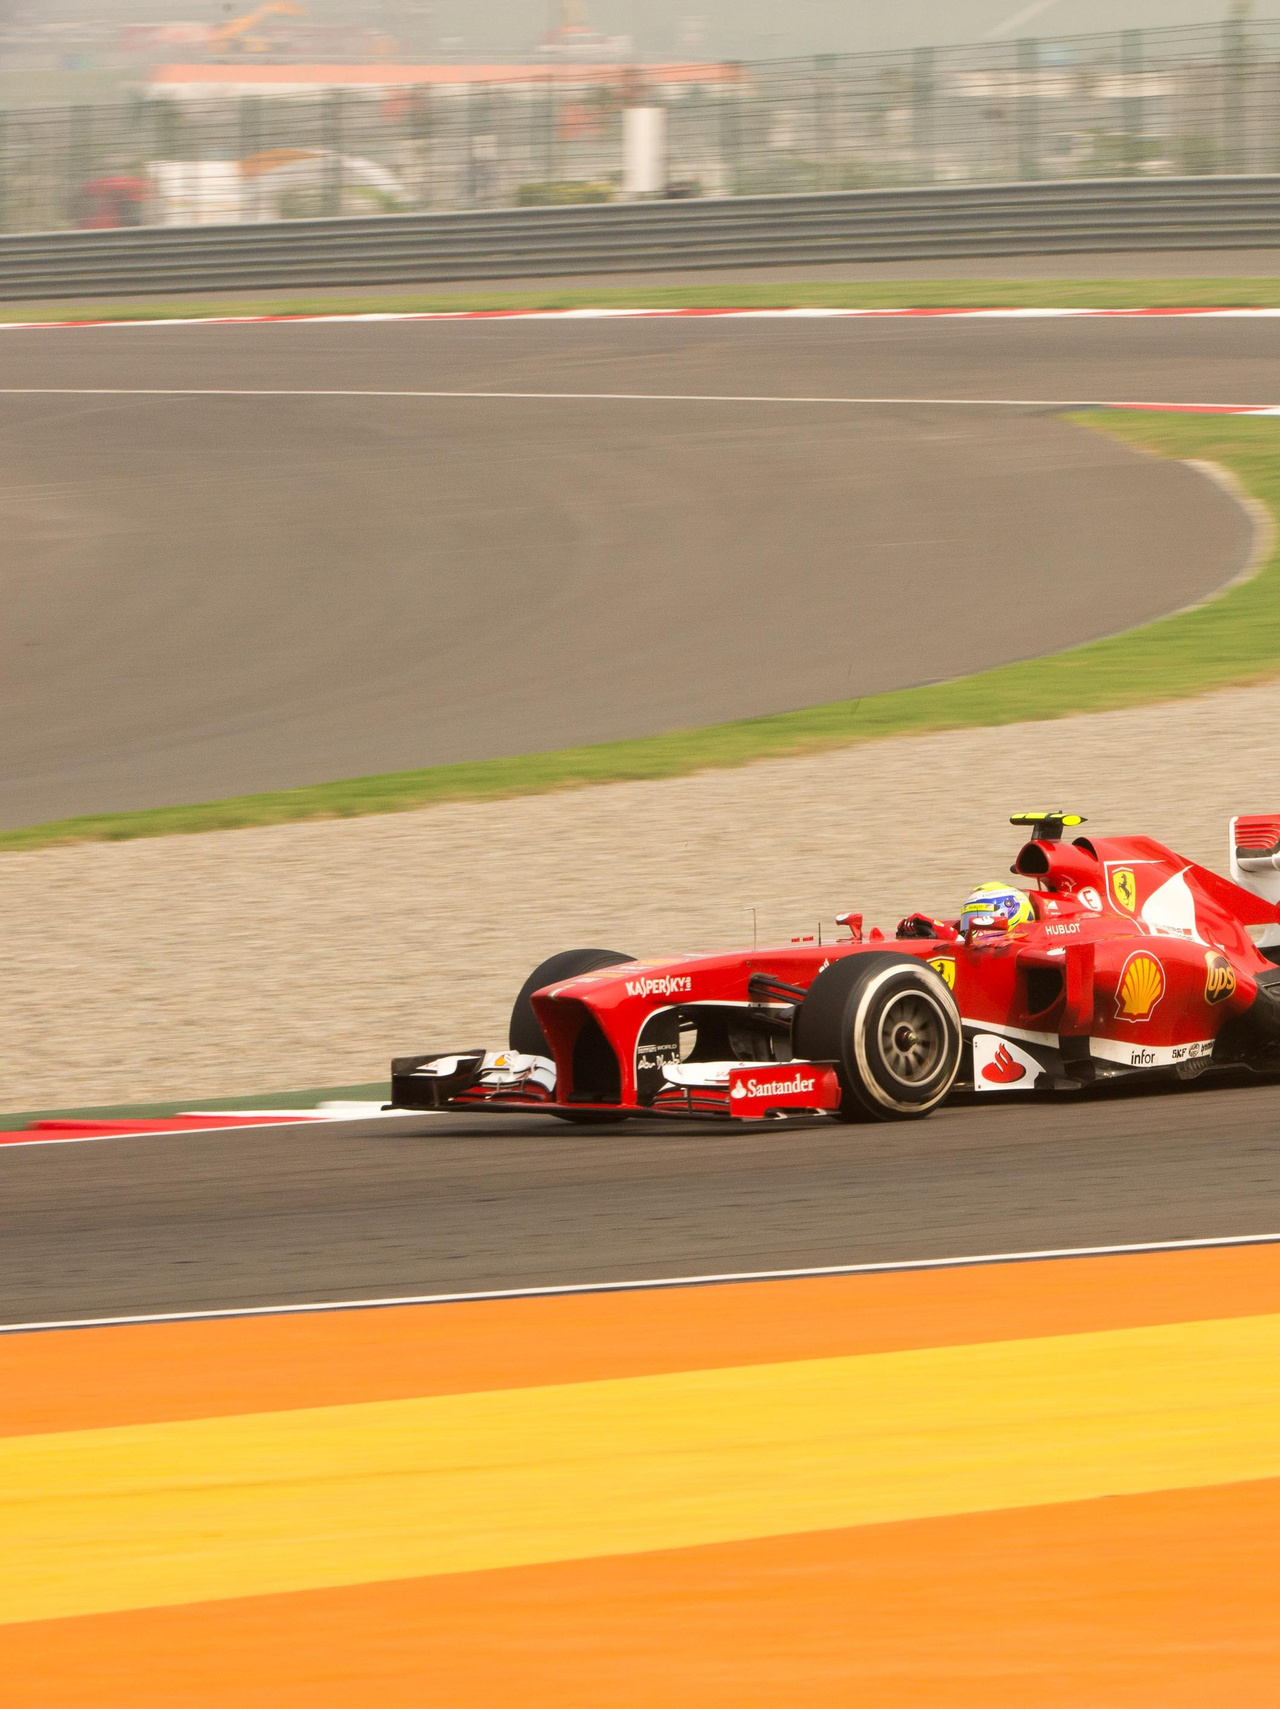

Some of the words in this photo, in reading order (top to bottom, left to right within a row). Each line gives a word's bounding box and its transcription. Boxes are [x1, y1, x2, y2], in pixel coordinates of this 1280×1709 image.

[1083, 890, 1098, 909] E
[1045, 923, 1080, 936] HUBLOT
[625, 975, 686, 998] KASPERSKY
[1208, 966, 1234, 998] ups
[1130, 1049, 1155, 1064] infor
[1172, 1048, 1187, 1059] SKF
[747, 1073, 816, 1098] Santander
